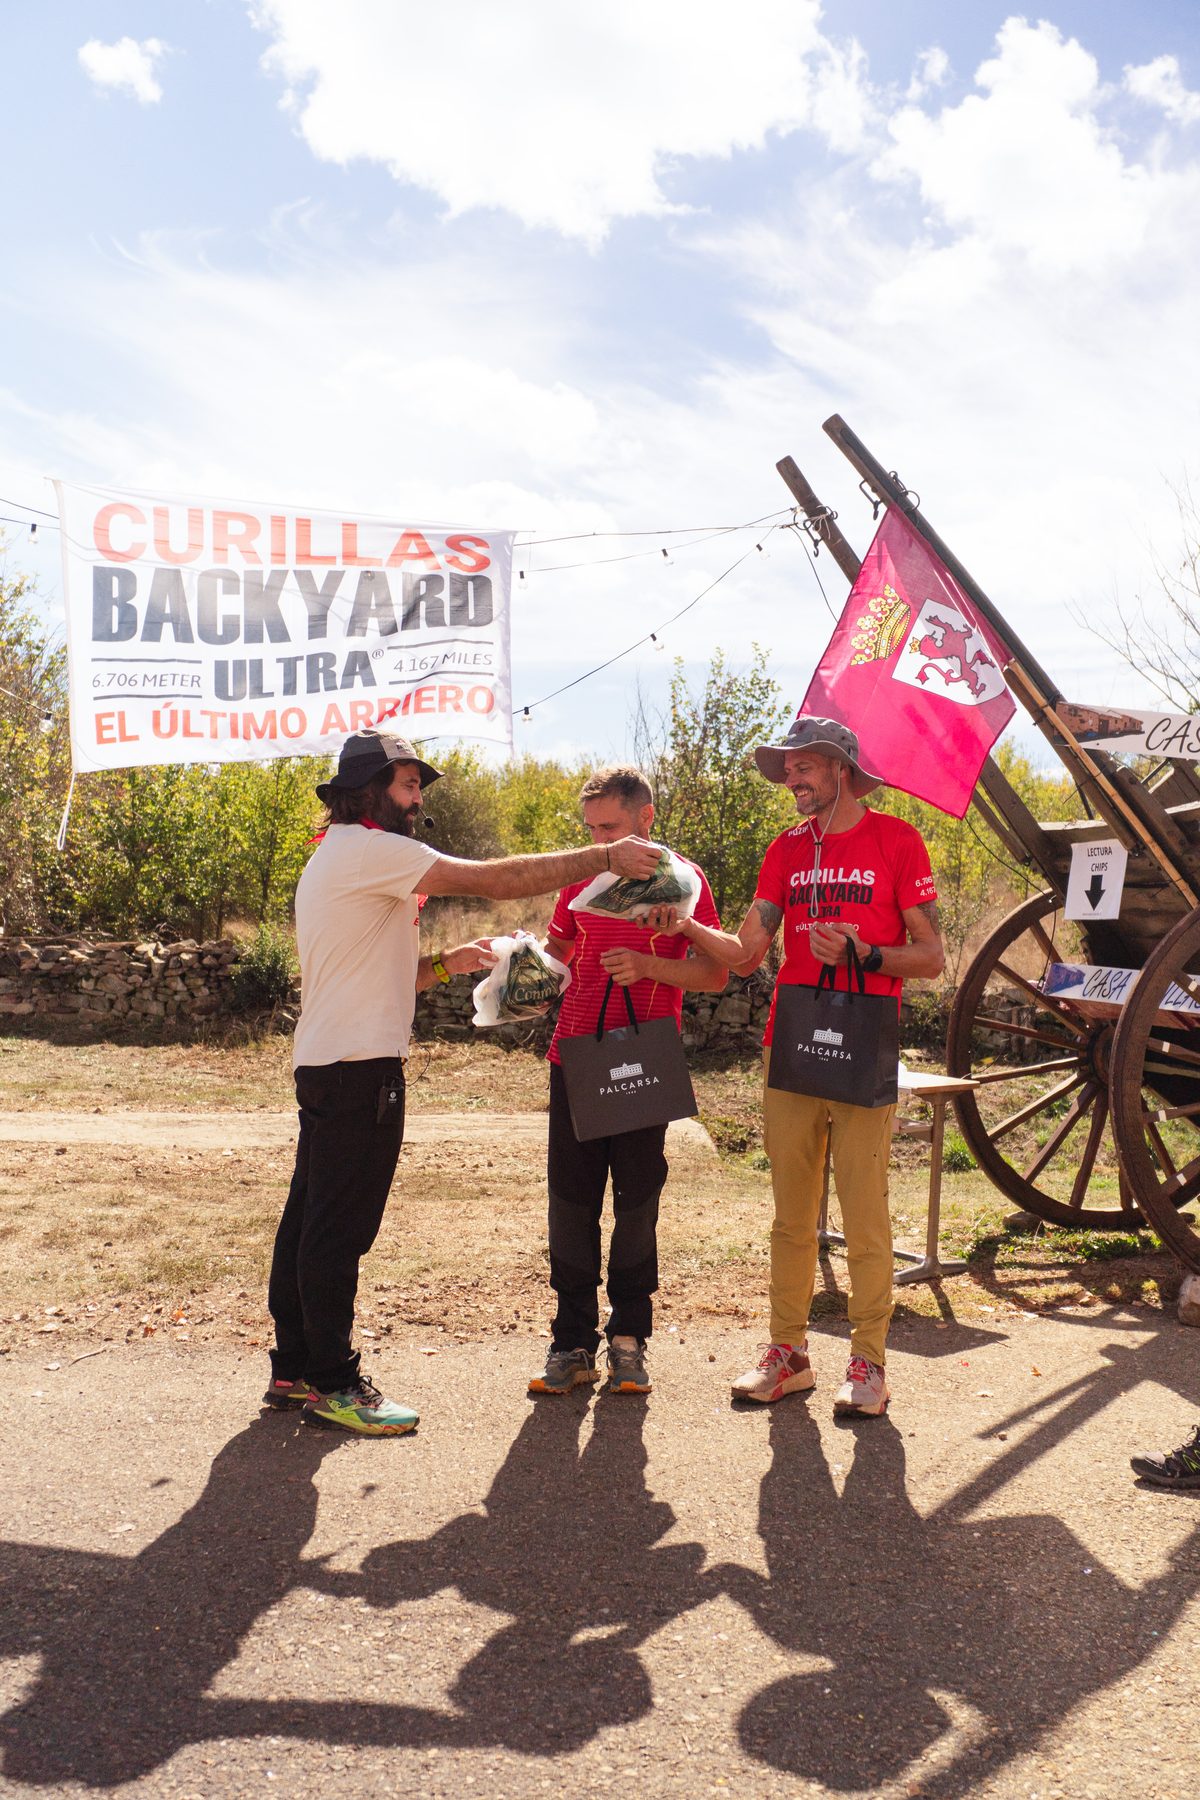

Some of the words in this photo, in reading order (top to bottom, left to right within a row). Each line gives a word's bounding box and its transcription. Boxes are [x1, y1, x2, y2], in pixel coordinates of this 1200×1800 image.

[93, 503, 491, 573] CURILLAS
[91, 565, 494, 645] BACKYARD
[393, 655, 439, 673] 4.167
[441, 651, 493, 666] MILES
[92, 672, 138, 688] 6.706
[142, 673, 201, 688] METER
[95, 710, 140, 745] EL
[152, 701, 308, 741] ÚLTIMO
[320, 685, 495, 736] ARRIERO
[1087, 846, 1113, 857] LECTURA
[790, 867, 876, 887] CURILLAS
[1090, 862, 1109, 872] CHIPS
[1082, 968, 1133, 1000] CASA
[797, 1043, 852, 1061] PALCARSA
[599, 1076, 660, 1096] PALCARSA
